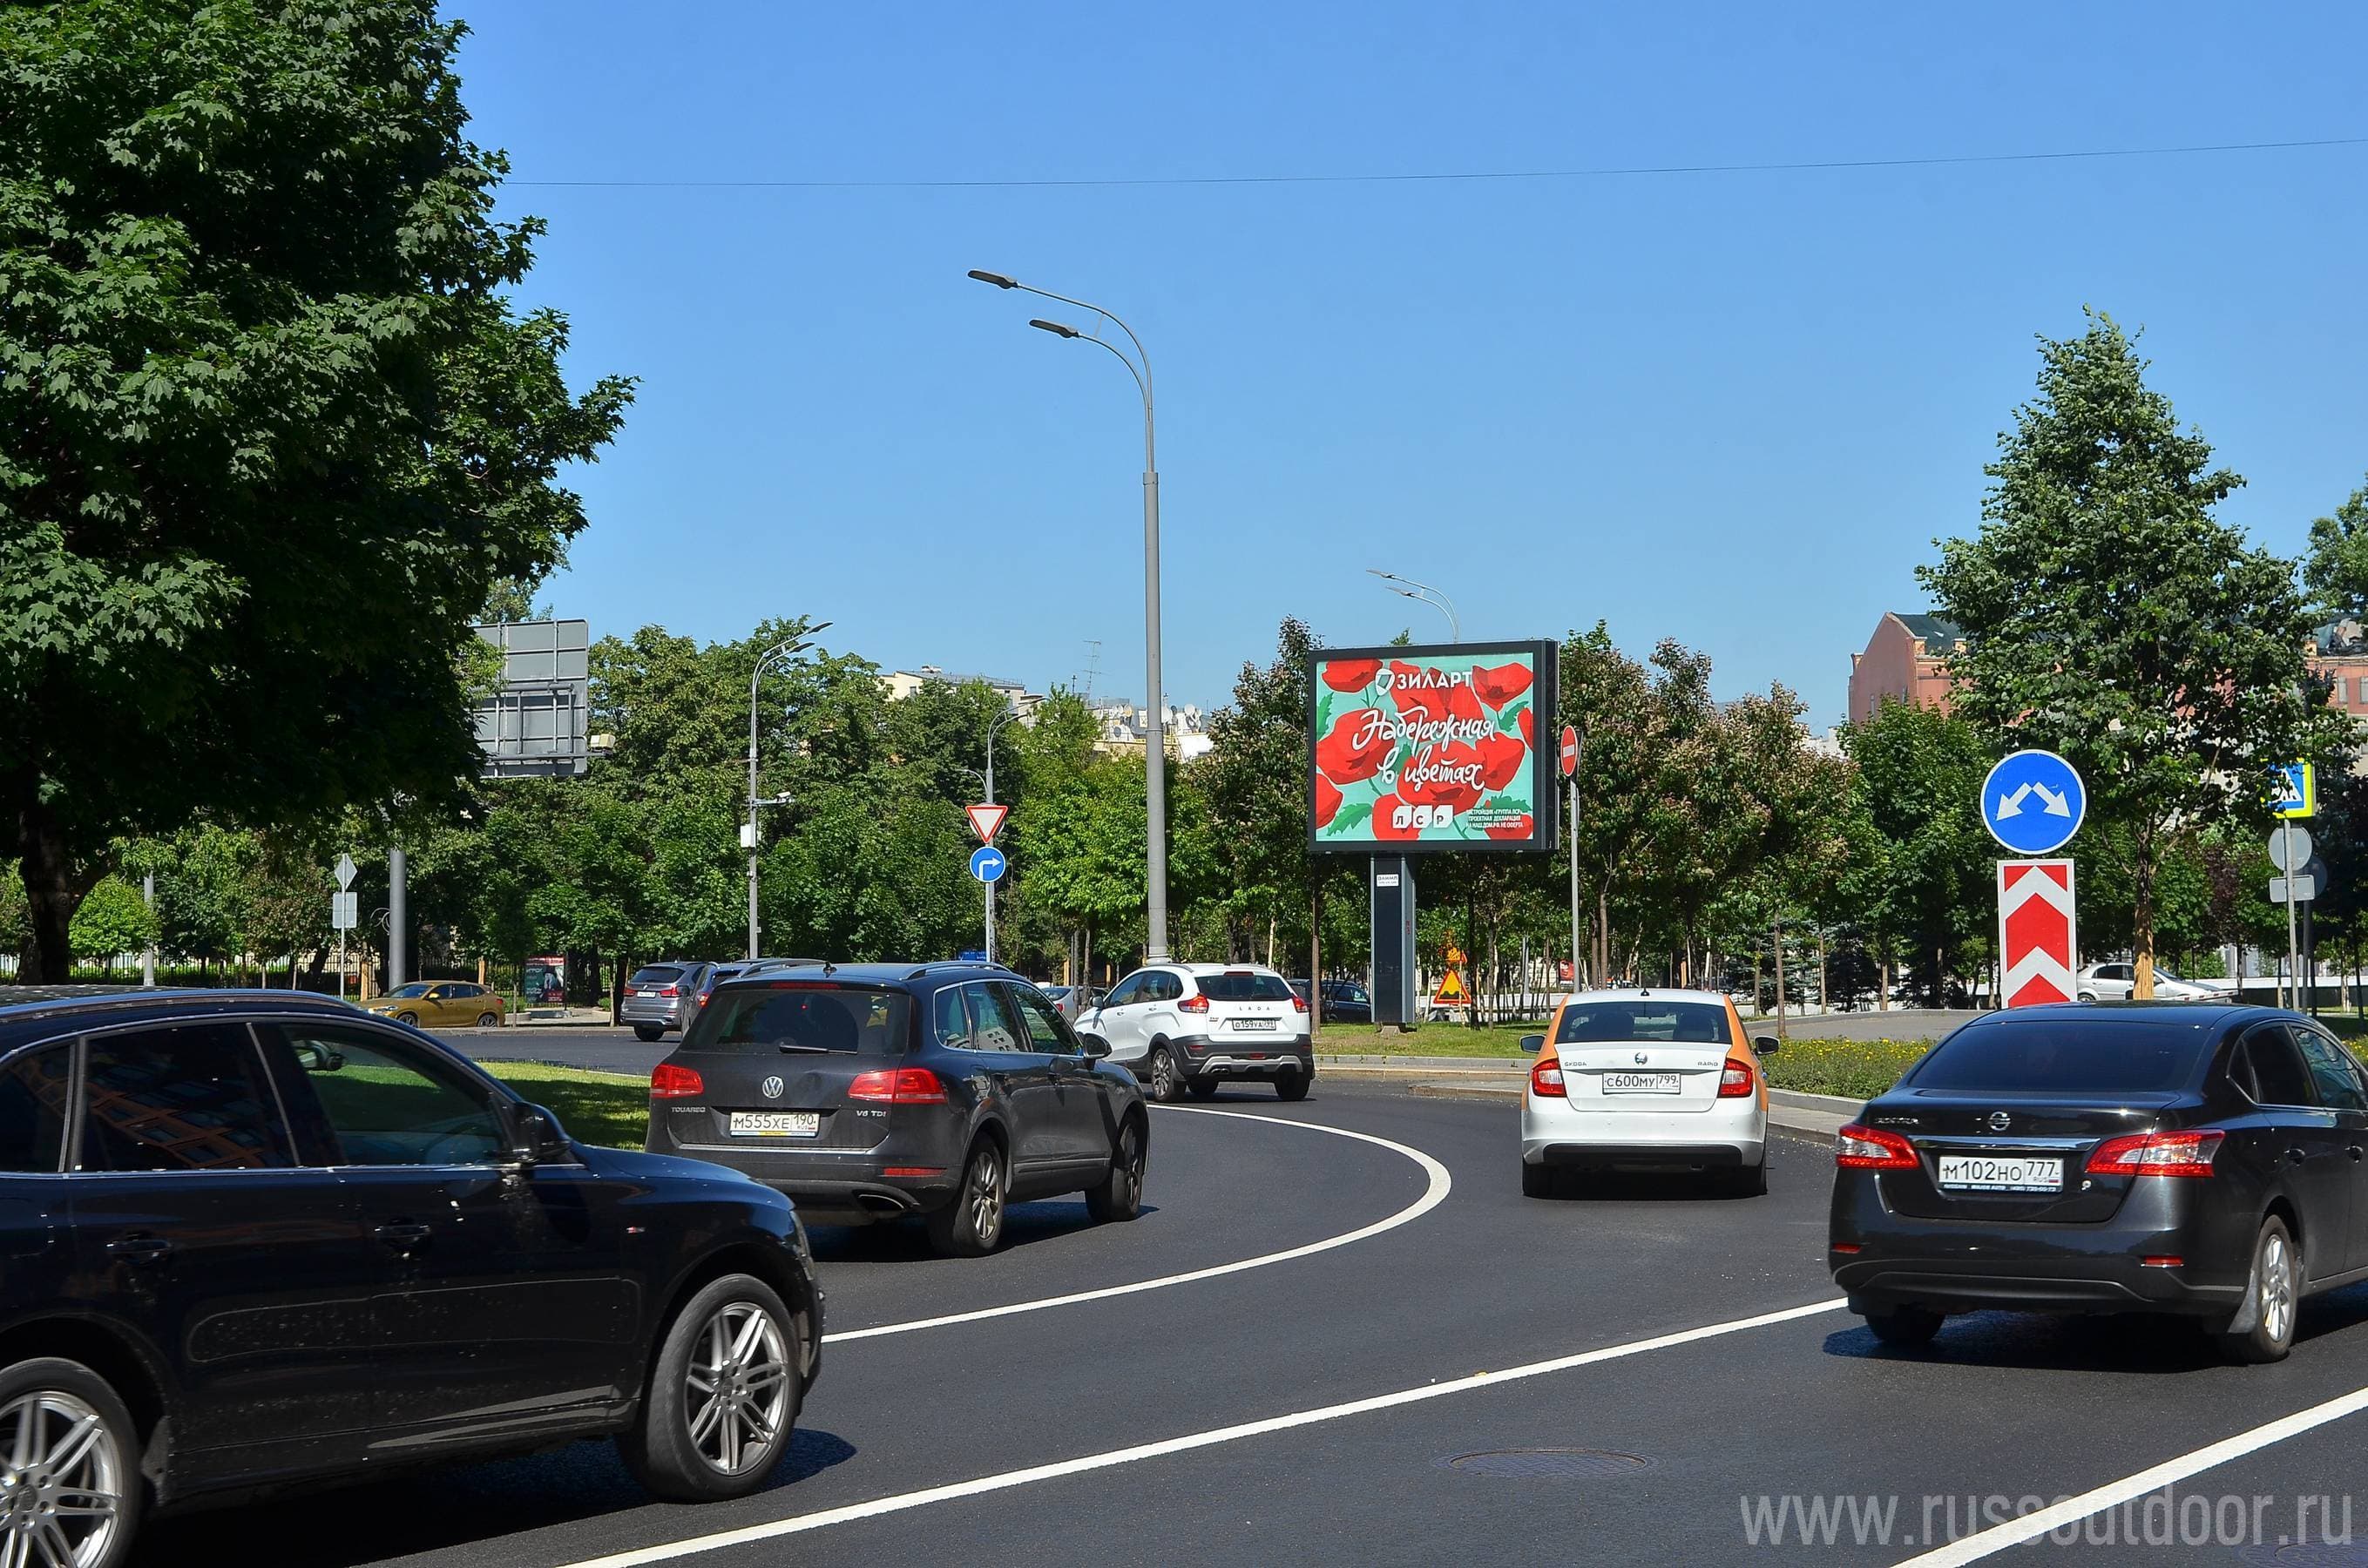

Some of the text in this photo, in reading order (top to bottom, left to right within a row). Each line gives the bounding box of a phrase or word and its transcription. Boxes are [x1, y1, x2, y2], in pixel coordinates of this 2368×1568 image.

[1397, 671, 1472, 690] ЗИЛАРТ
[1351, 705, 1497, 758] Набережная
[1376, 744, 1485, 793] в цветах
[1607, 1075, 1676, 1087] С600МУ 799
[734, 1114, 813, 1129] М555ХЕ 190
[1943, 1160, 2055, 1181] М102НО 777
